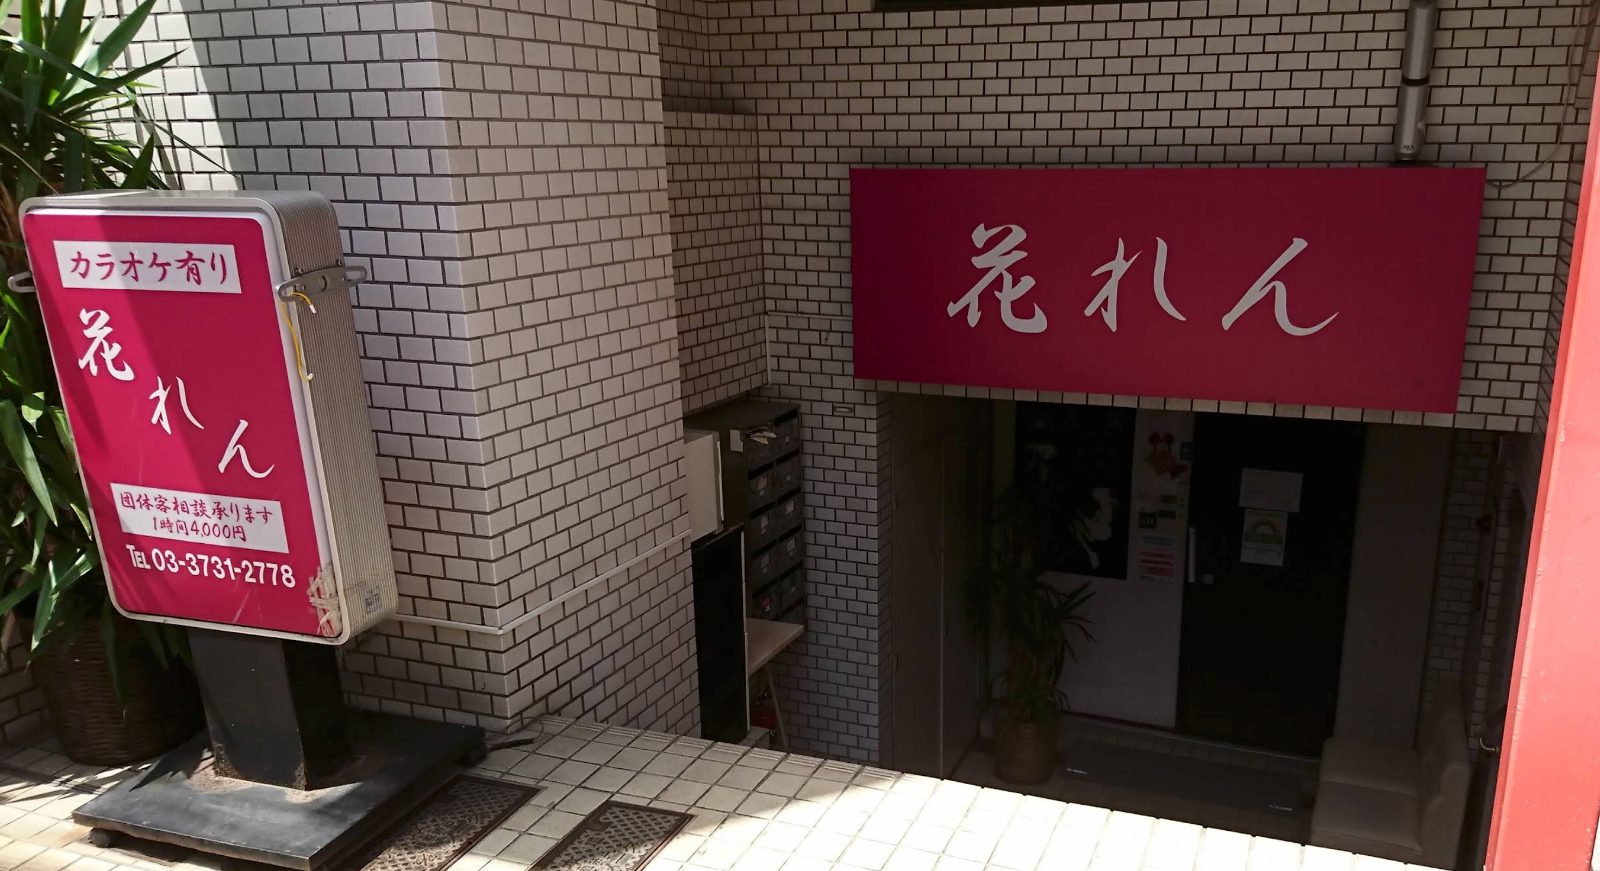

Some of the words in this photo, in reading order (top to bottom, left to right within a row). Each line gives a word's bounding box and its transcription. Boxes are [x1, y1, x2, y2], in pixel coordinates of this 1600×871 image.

[70, 250, 226, 286] カラオケ有り
[946, 222, 1339, 337] 花れん
[78, 308, 275, 479] 花れん
[120, 491, 273, 524] 団体客相談承ります
[152, 516, 247, 542] 1時間4,000円
[151, 548, 296, 588] 03-3731-2778
